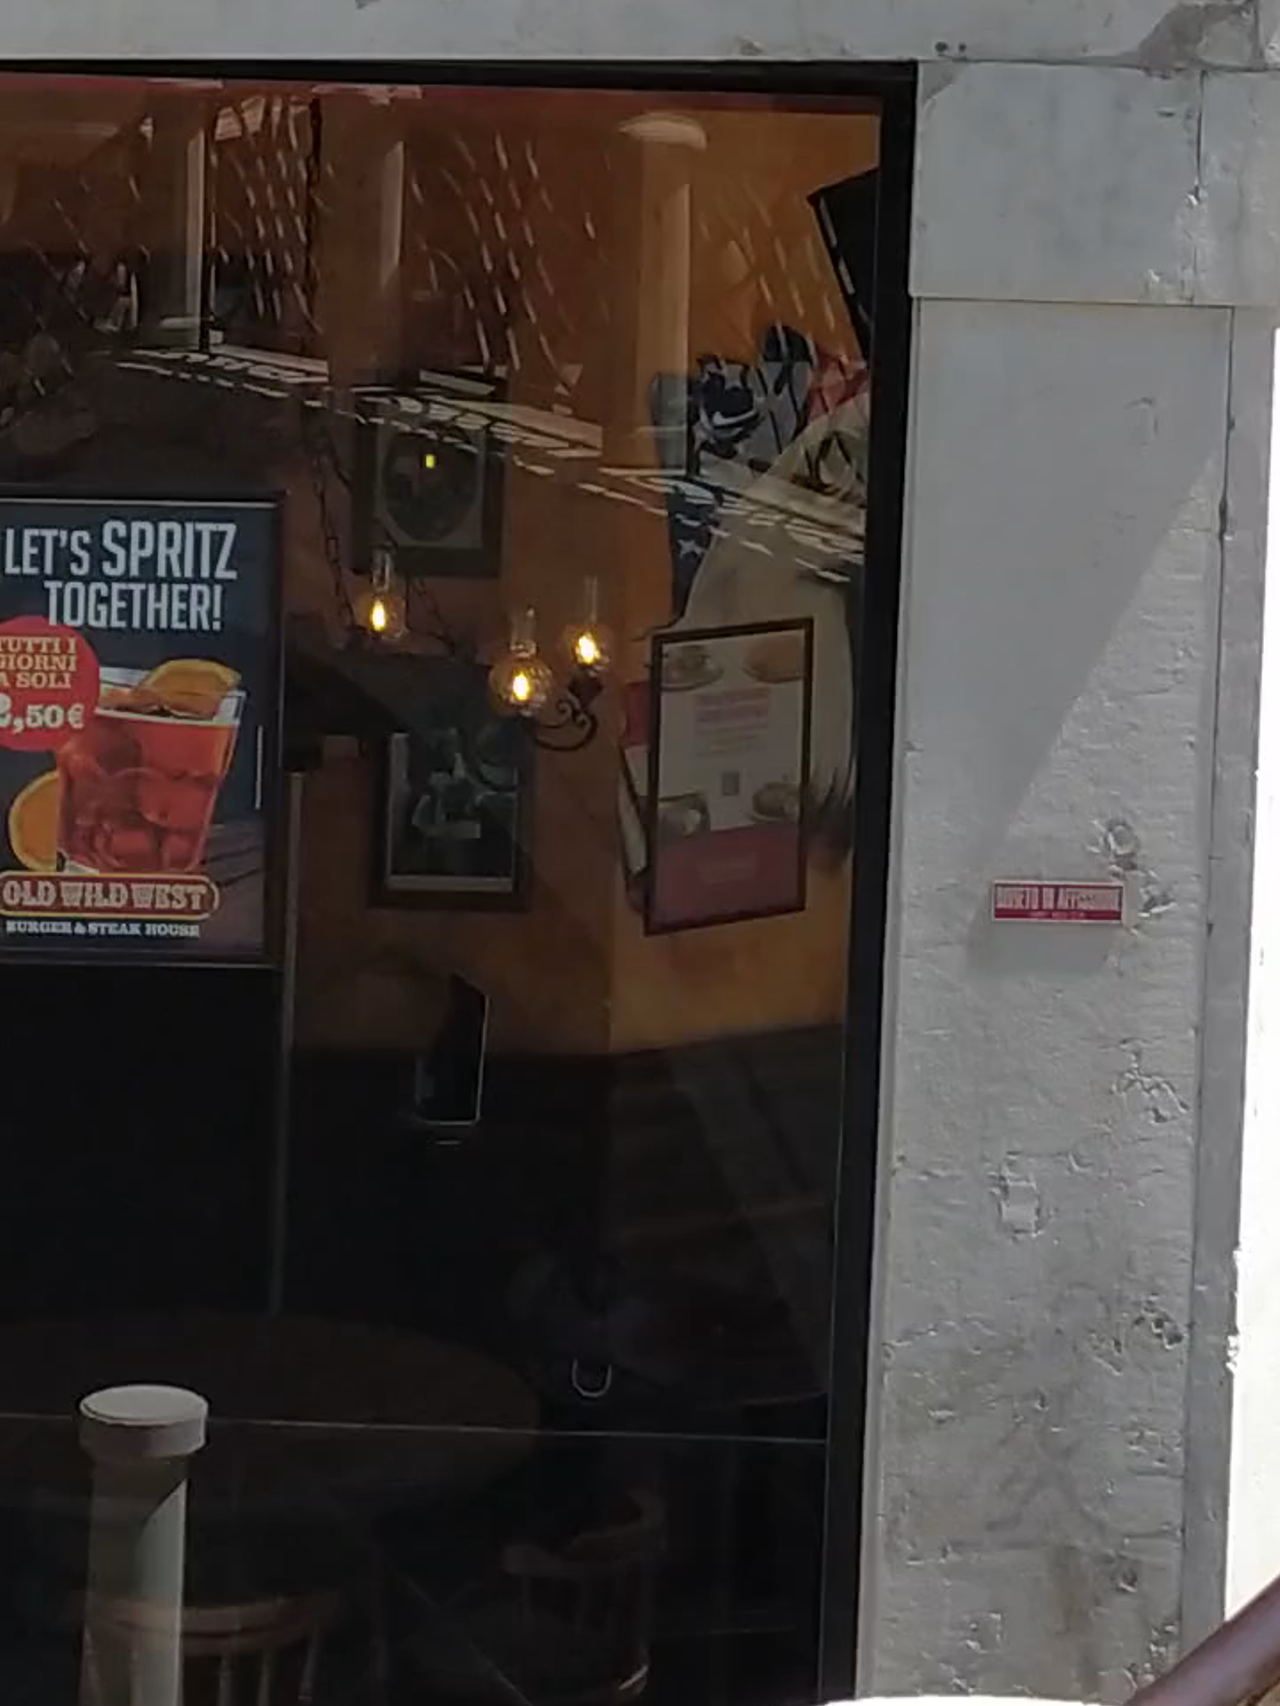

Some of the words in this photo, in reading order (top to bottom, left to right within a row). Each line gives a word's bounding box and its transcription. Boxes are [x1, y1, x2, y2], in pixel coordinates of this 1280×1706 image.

[4, 527, 92, 576] LET'S
[102, 519, 238, 579] SPRITZ
[43, 580, 222, 631] TOGETHER!
[67, 637, 77, 654] I
[15, 672, 71, 689] SOLI
[2, 880, 57, 907] OLD
[60, 881, 128, 908] WILD
[131, 882, 207, 910] WEST
[6, 920, 72, 934] BURGER
[88, 923, 142, 936] STEAK
[145, 923, 200, 937] HOUSE
